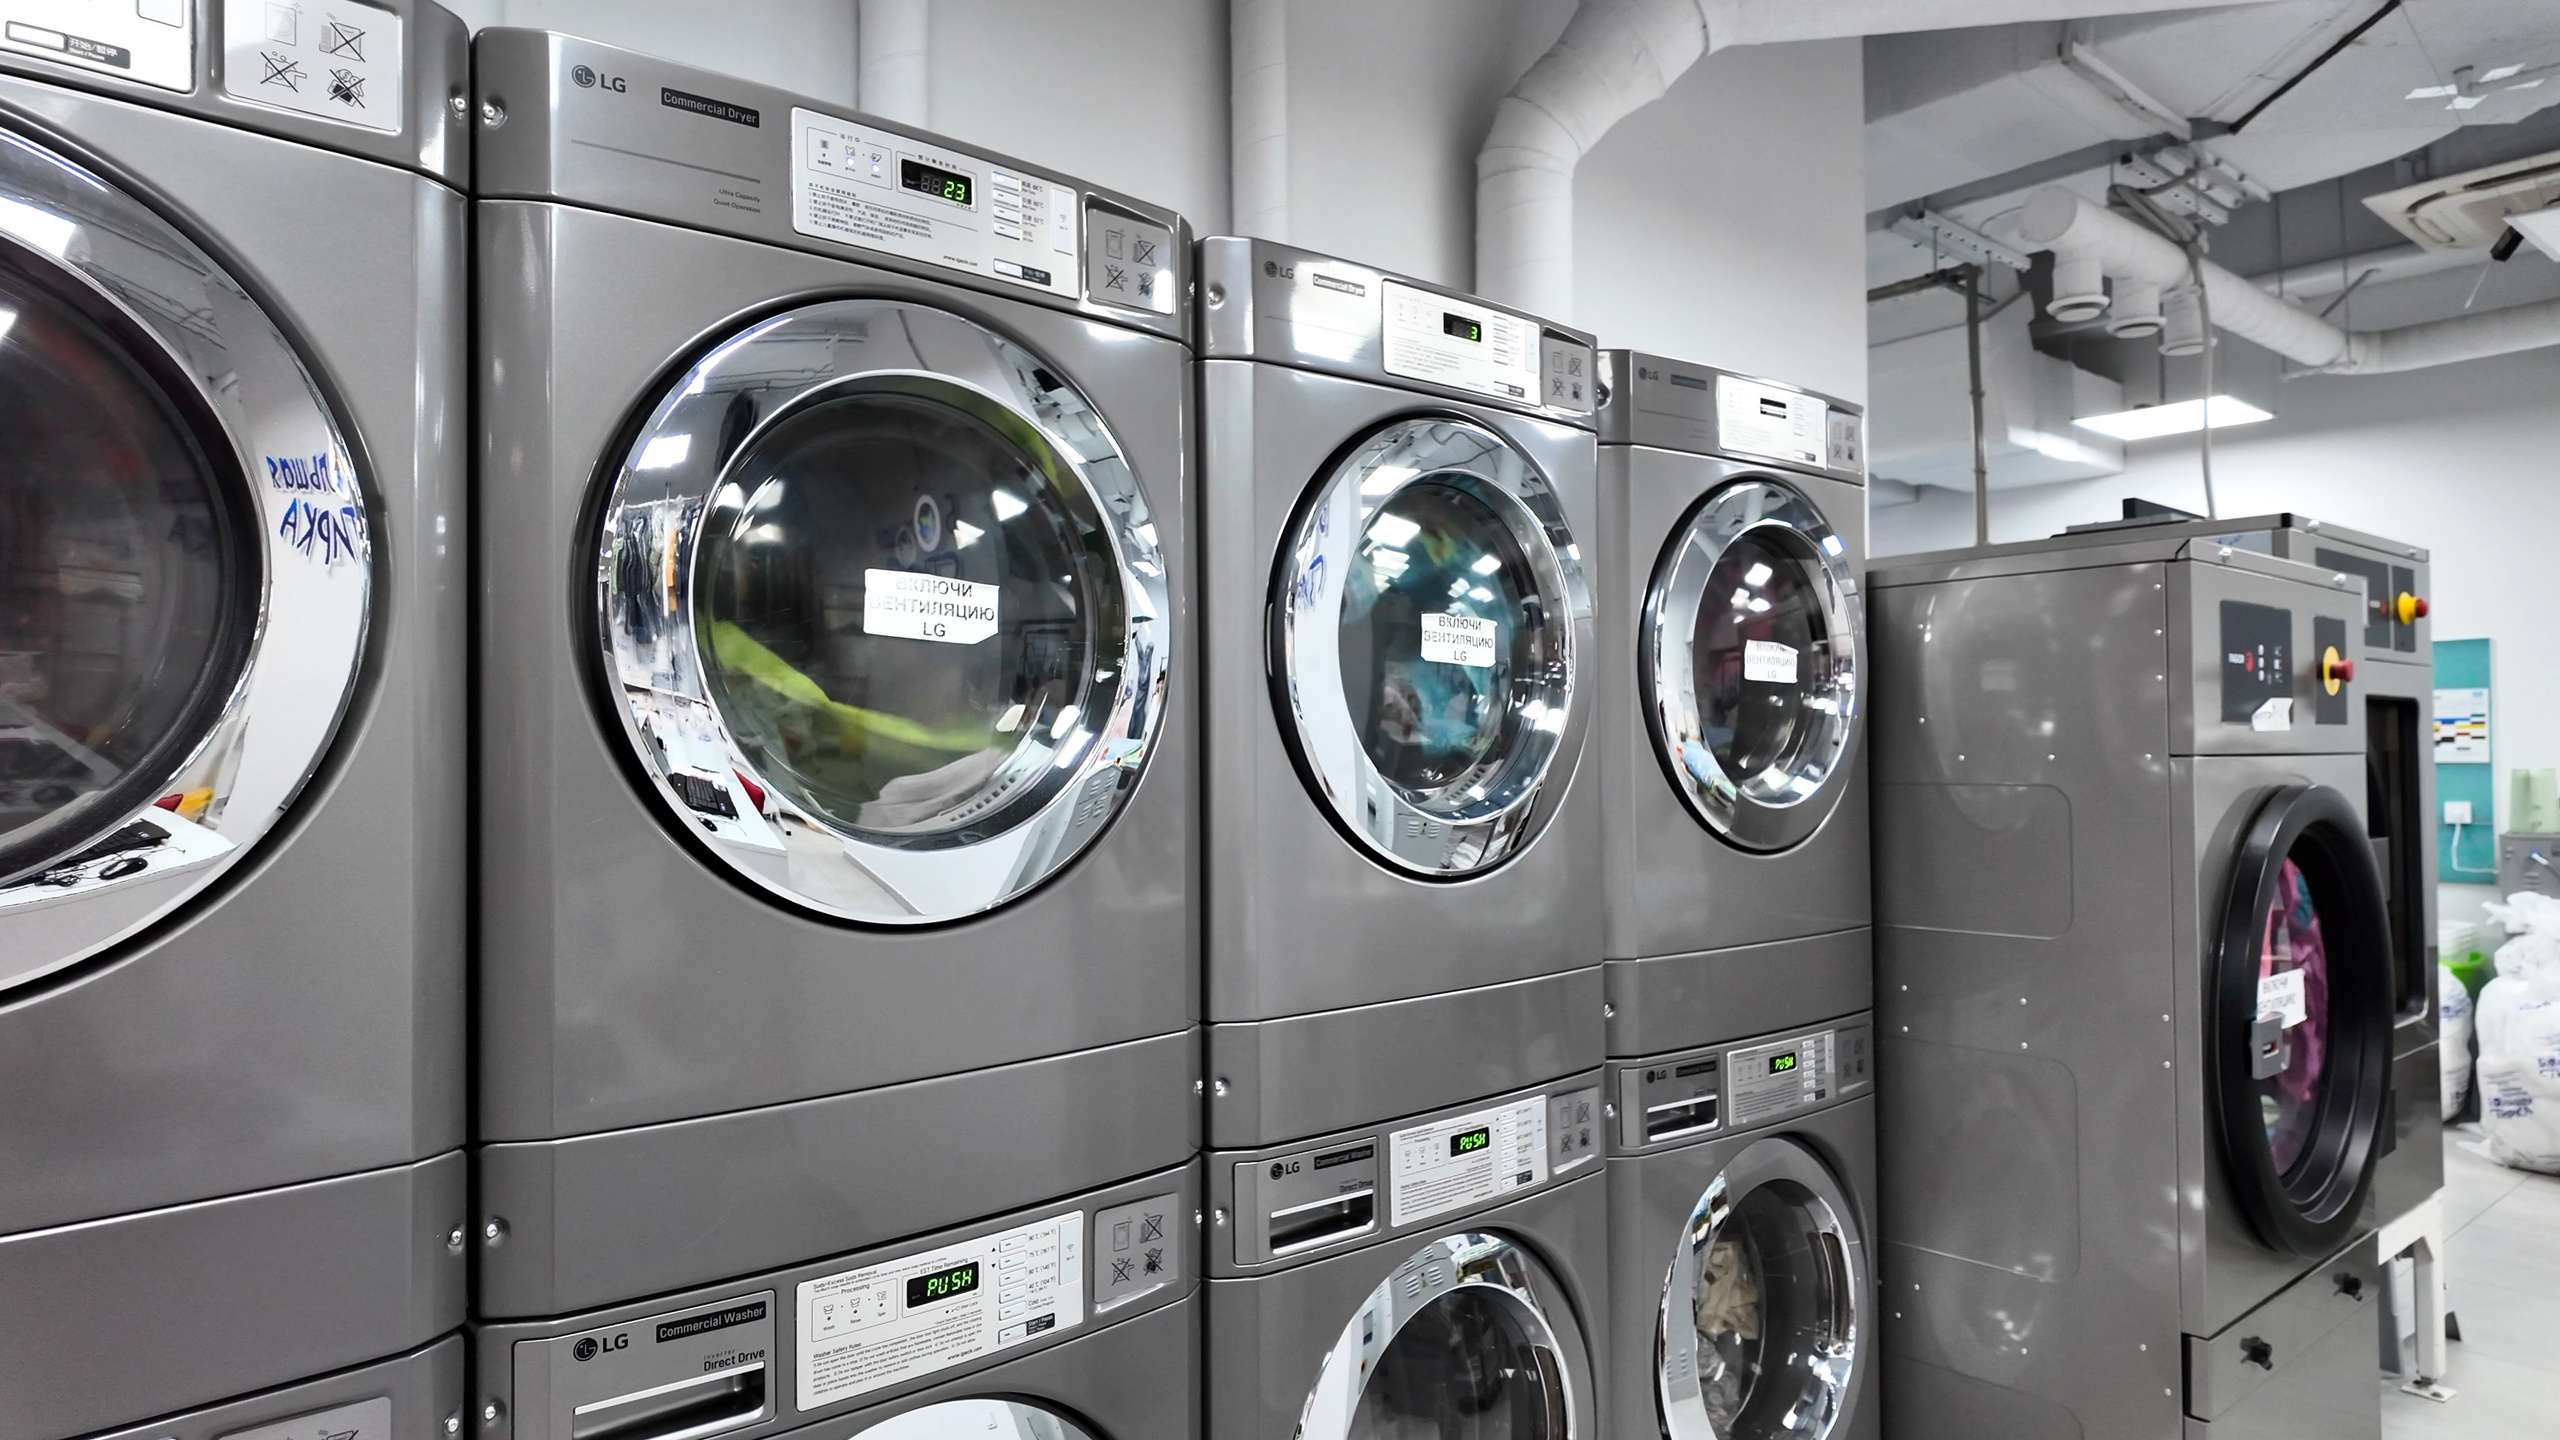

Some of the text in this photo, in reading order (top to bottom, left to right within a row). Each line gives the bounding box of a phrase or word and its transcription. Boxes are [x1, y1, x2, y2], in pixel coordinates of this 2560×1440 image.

[600, 73, 627, 93] LG
[663, 92, 757, 123] Commercial Dryer
[719, 188, 760, 203] Ultra Capacity
[944, 181, 965, 201] 23
[713, 198, 760, 213] Quiet Operation
[1279, 267, 1294, 279] LG
[1470, 326, 1478, 340] 3
[923, 622, 946, 637] LG
[1438, 616, 1482, 631] ВКЛЮЧИ
[1424, 630, 1493, 649] ВЕНТИЛЯЦИЮ
[1454, 650, 1467, 661] LG
[1774, 1055, 1793, 1071] PUSH
[1656, 1069, 1667, 1080] LG
[1460, 1132, 1486, 1150] PUSH
[1286, 1161, 1300, 1175] LG
[841, 1283, 870, 1294] Processing
[927, 1269, 972, 1297] PUSH
[660, 1307, 764, 1339] Commercial Washer
[602, 1333, 629, 1353] LG
[704, 1349, 765, 1372] Direct Drive
